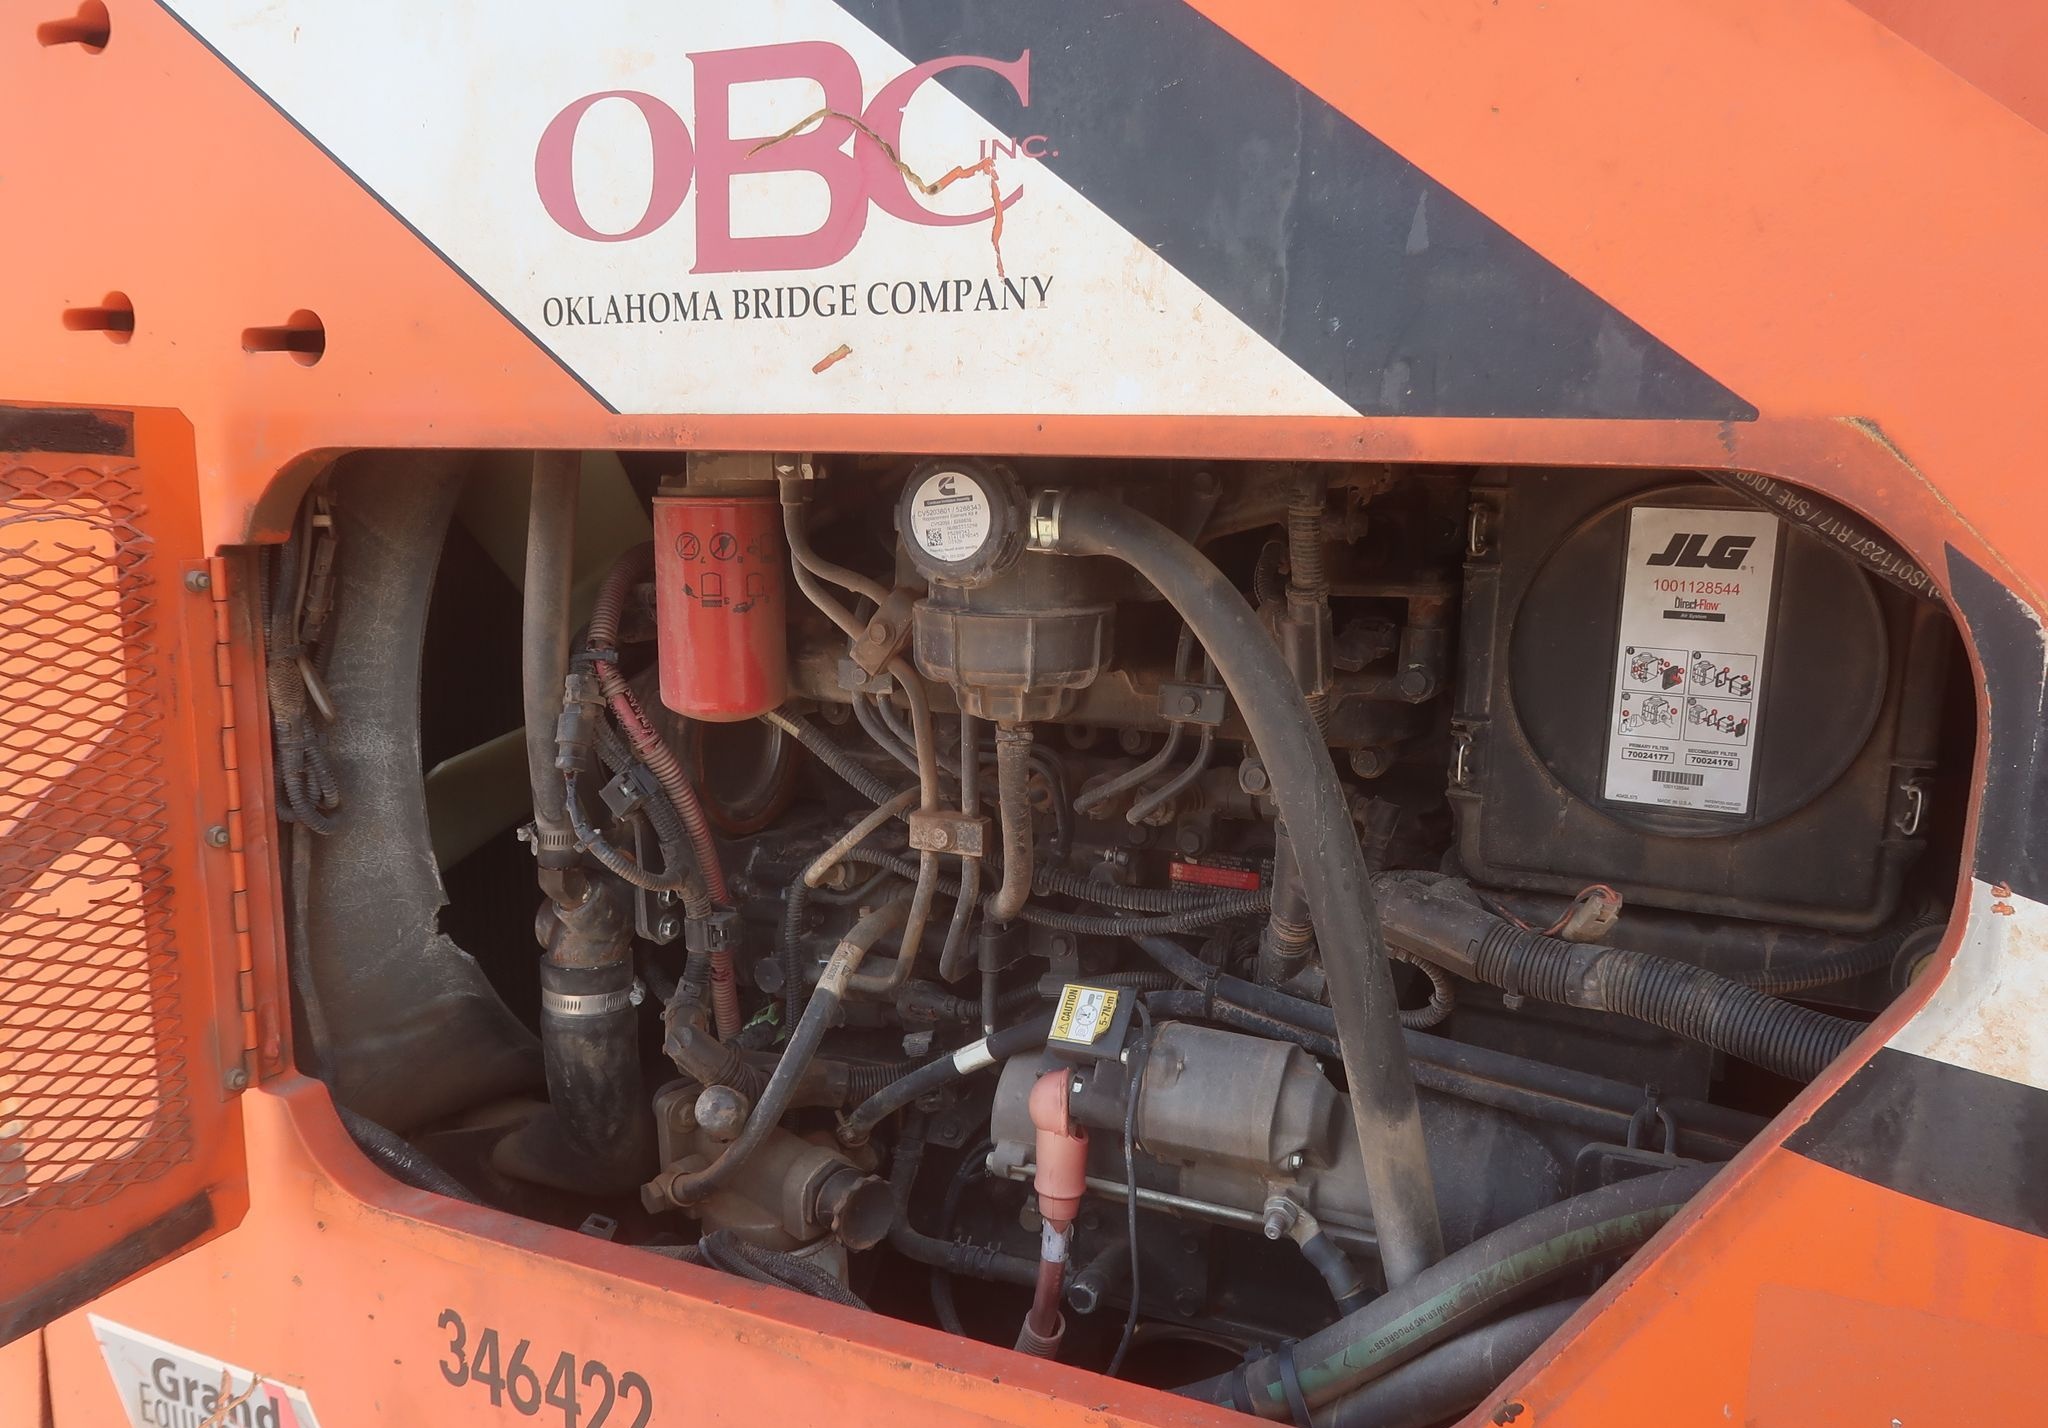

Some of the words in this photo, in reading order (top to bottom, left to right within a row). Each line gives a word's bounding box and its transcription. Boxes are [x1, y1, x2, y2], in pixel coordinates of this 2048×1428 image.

[535, 41, 1030, 274] OBC
[979, 134, 1059, 160] INC.
[543, 290, 723, 328] OKLAHOMA
[732, 283, 858, 320] BRIDGE
[867, 275, 1054, 316] COMPANY
[1775, 488, 1811, 517] SAE
[1646, 533, 1756, 570] JLG
[1654, 578, 1741, 596] 1001128544
[1627, 751, 1669, 761] 70024177
[1691, 756, 1734, 767] 70024176
[1060, 988, 1079, 1022] CAUTION
[437, 1308, 653, 1428] 346422
[152, 1357, 281, 1428] Grand
